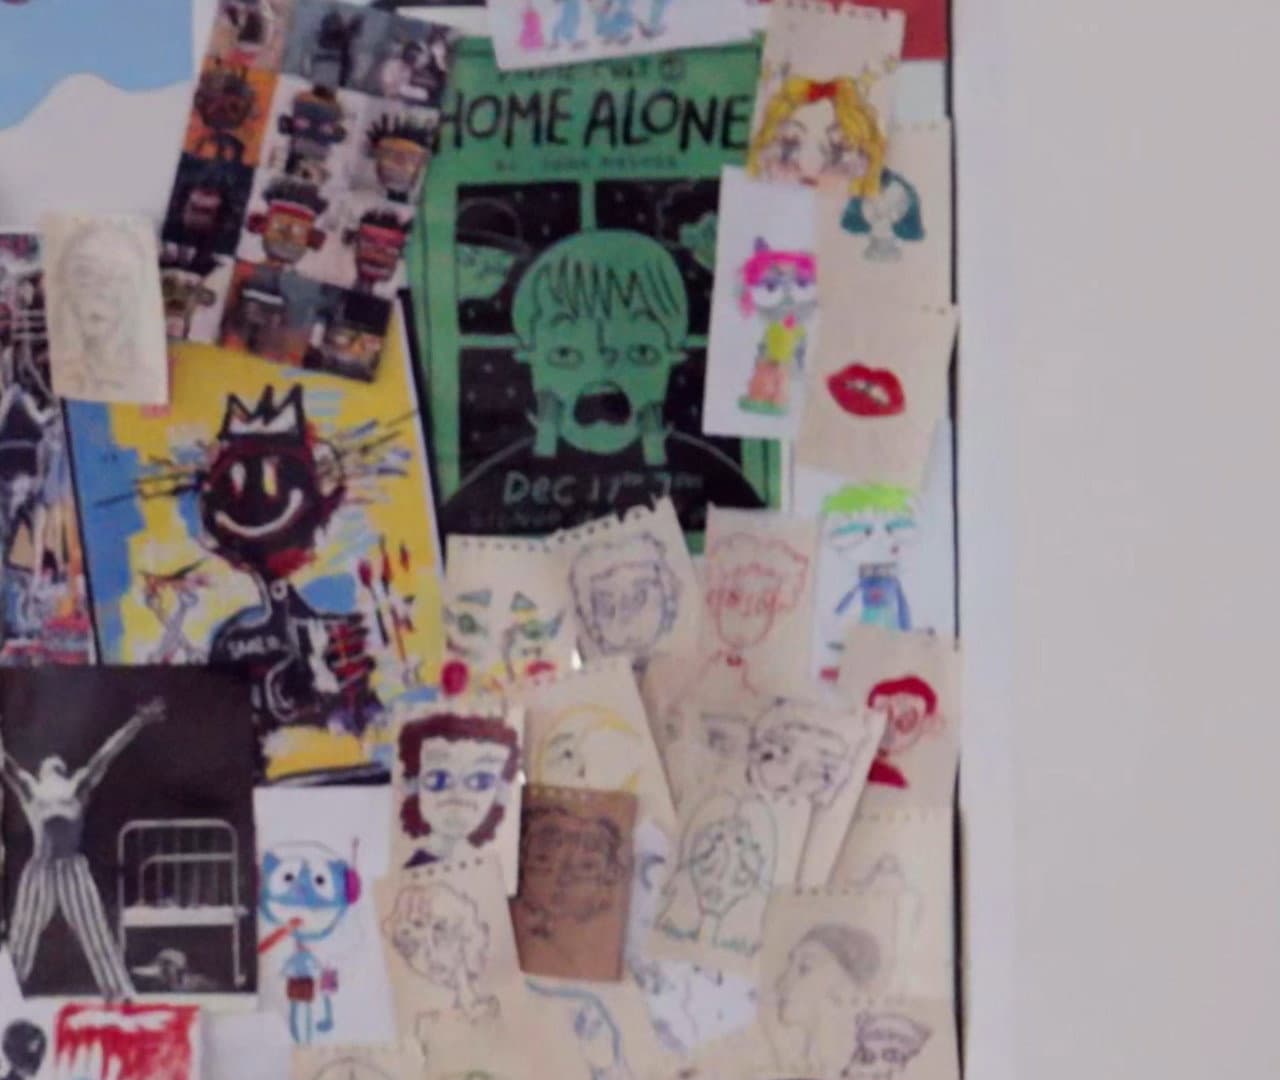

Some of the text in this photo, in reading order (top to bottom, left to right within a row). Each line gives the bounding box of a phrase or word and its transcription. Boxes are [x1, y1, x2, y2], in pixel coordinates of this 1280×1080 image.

[432, 86, 752, 150] HOME ALONE
[503, 470, 577, 506] Dec
